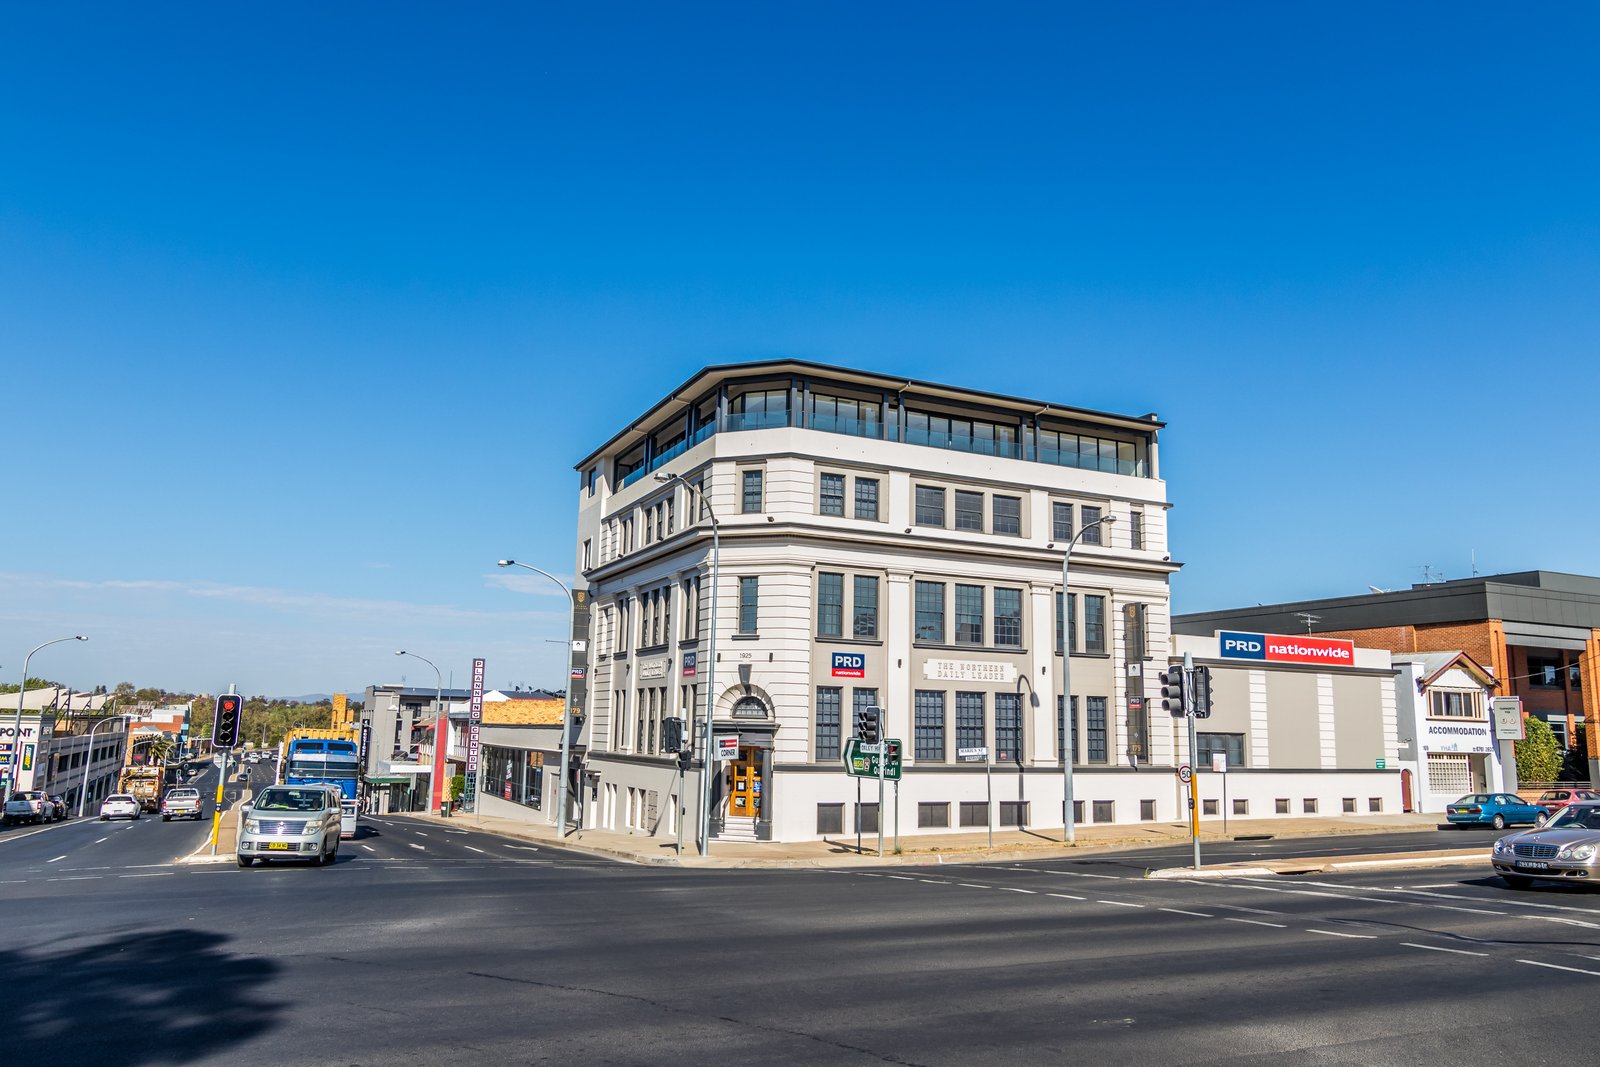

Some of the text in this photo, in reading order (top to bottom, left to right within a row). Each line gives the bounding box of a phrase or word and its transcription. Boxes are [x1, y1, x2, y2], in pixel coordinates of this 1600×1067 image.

[1225, 639, 1350, 659] PRD nationwide
[684, 655, 695, 667] PRD
[835, 655, 862, 668] PRD
[938, 662, 1005, 673] THE NORTHERN
[937, 670, 1005, 681] DAILY LEADER
[472, 661, 482, 718] PLANNING
[0, 727, 33, 737] PONT
[1428, 726, 1487, 736] ACCOMMODATION
[469, 727, 479, 770] CENTRE
[721, 749, 736, 757] CORNER
[1182, 770, 1192, 779] 50
